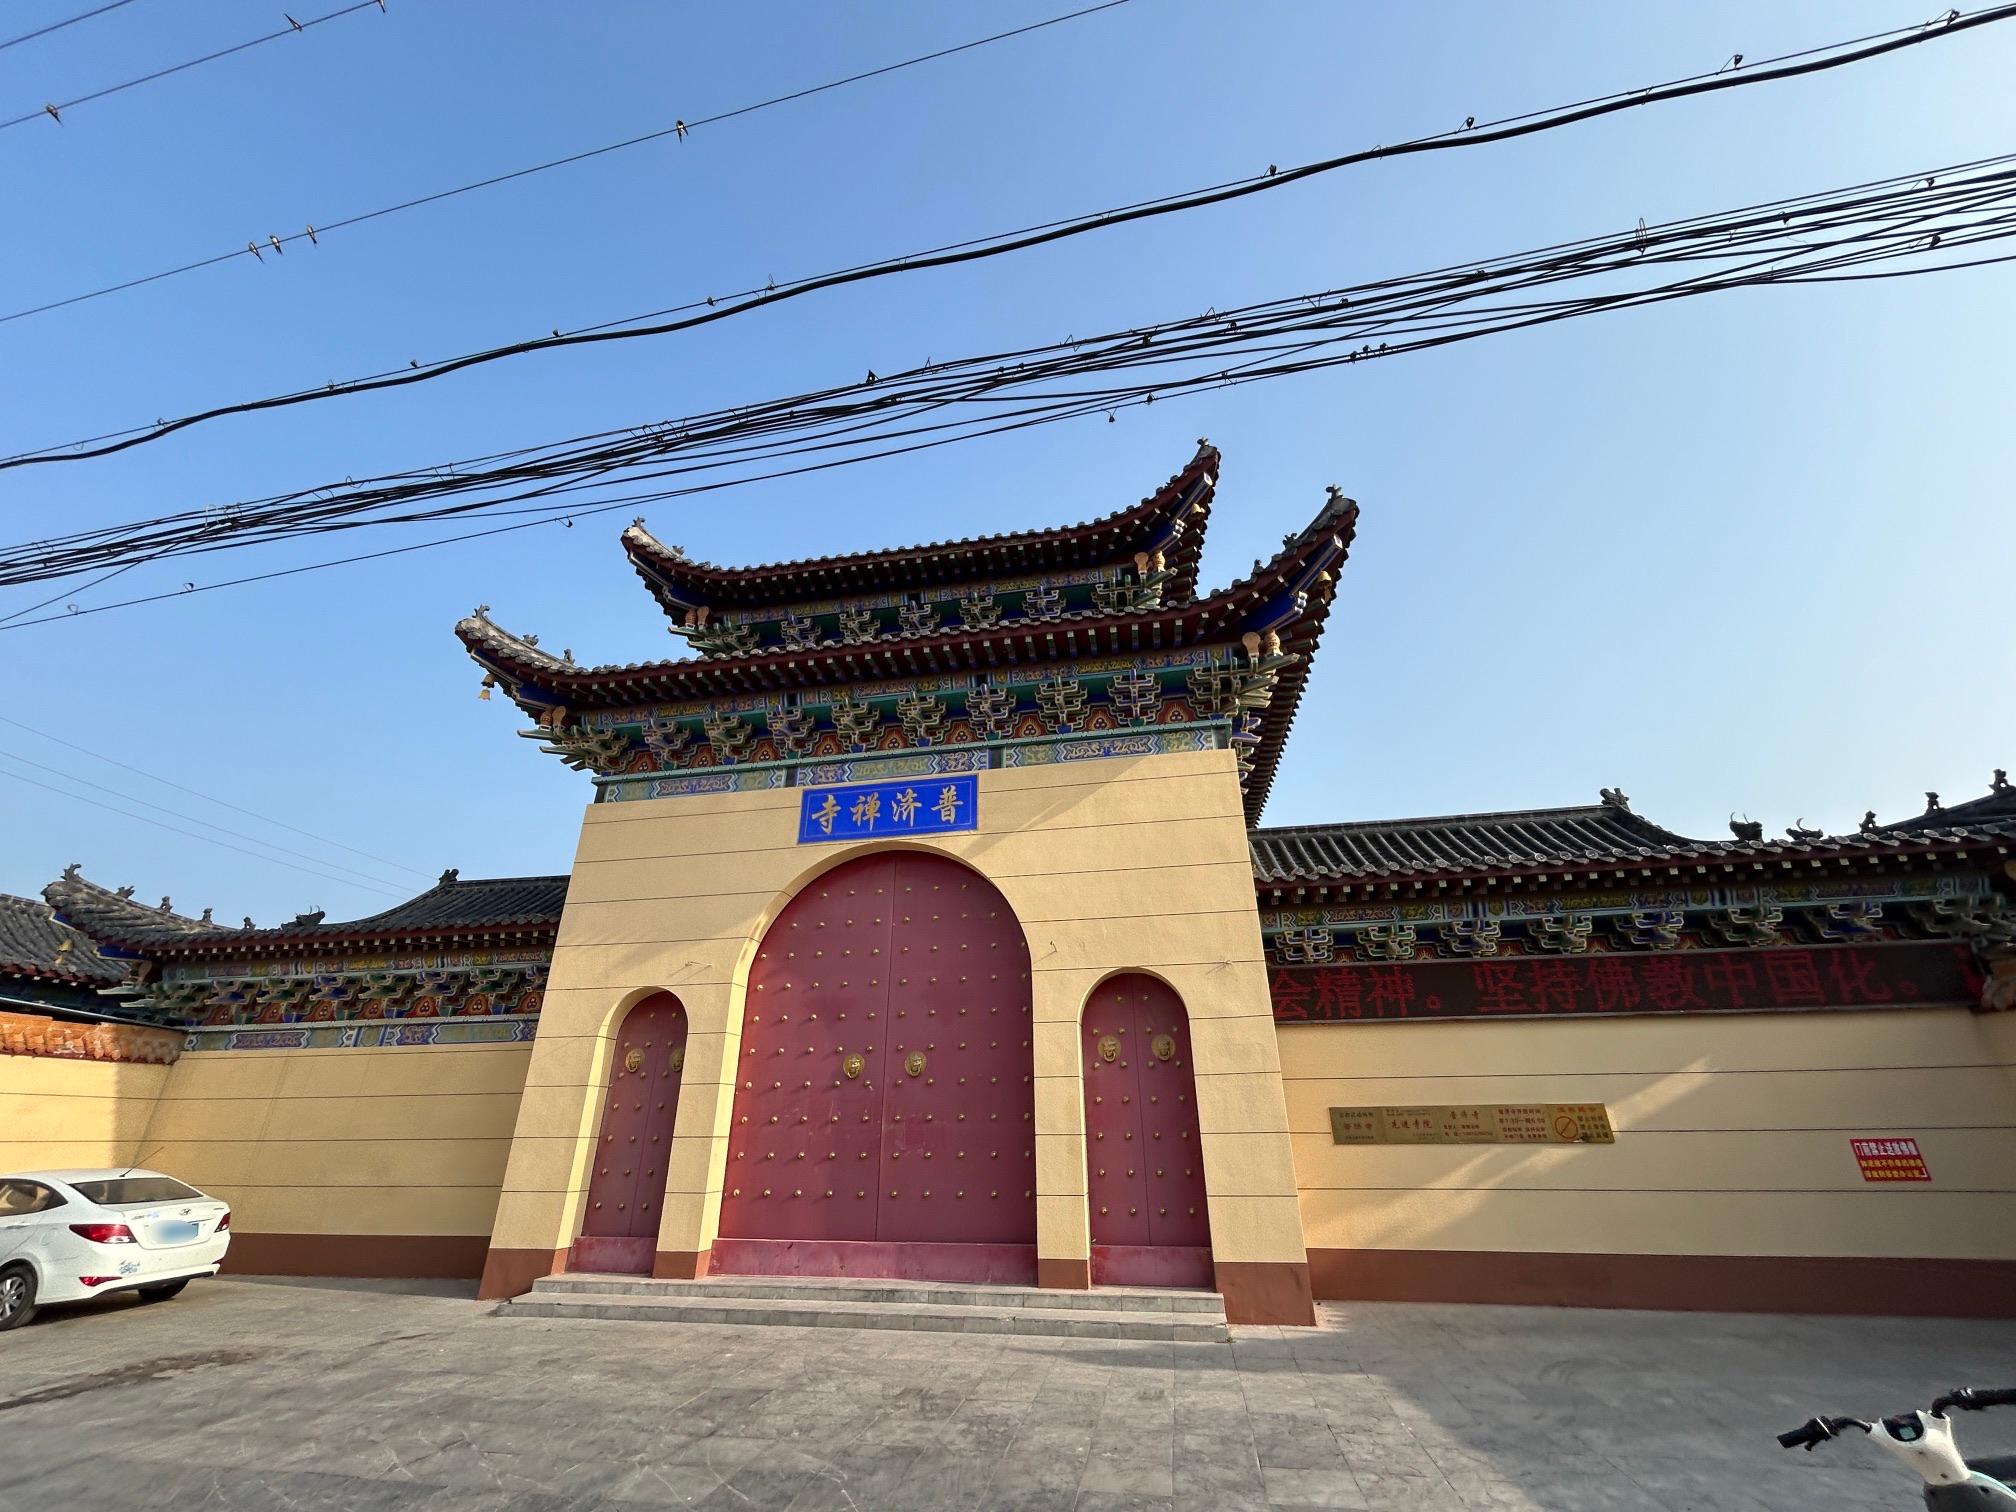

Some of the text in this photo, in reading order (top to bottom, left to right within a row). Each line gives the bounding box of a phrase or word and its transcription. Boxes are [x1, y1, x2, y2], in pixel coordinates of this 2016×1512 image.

[812, 785, 964, 834] 普济禅寺
[1271, 945, 1984, 1019] 会精神。坚持佛教中国化。
